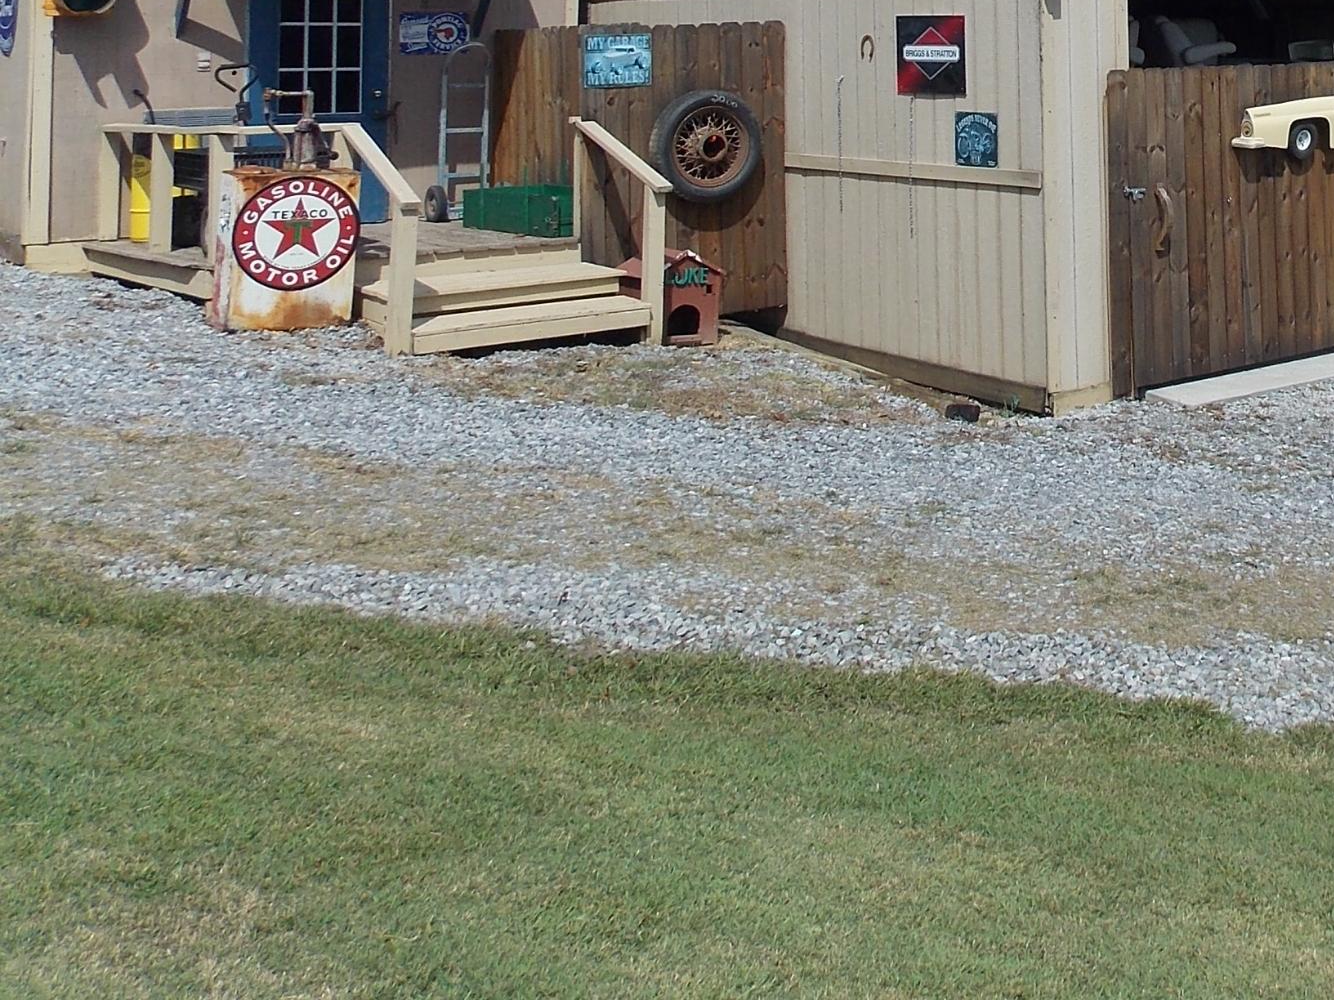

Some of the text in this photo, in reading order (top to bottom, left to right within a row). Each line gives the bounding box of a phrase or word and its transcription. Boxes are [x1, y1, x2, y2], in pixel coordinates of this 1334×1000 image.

[587, 35, 650, 51] MY GARAGE
[905, 49, 926, 58] BRIGGS
[930, 49, 957, 59] STRATTON
[587, 71, 606, 85] MY
[243, 180, 354, 225] GASOLINE
[271, 208, 329, 220] TEXACO
[238, 234, 355, 286] MOTOR OIL
